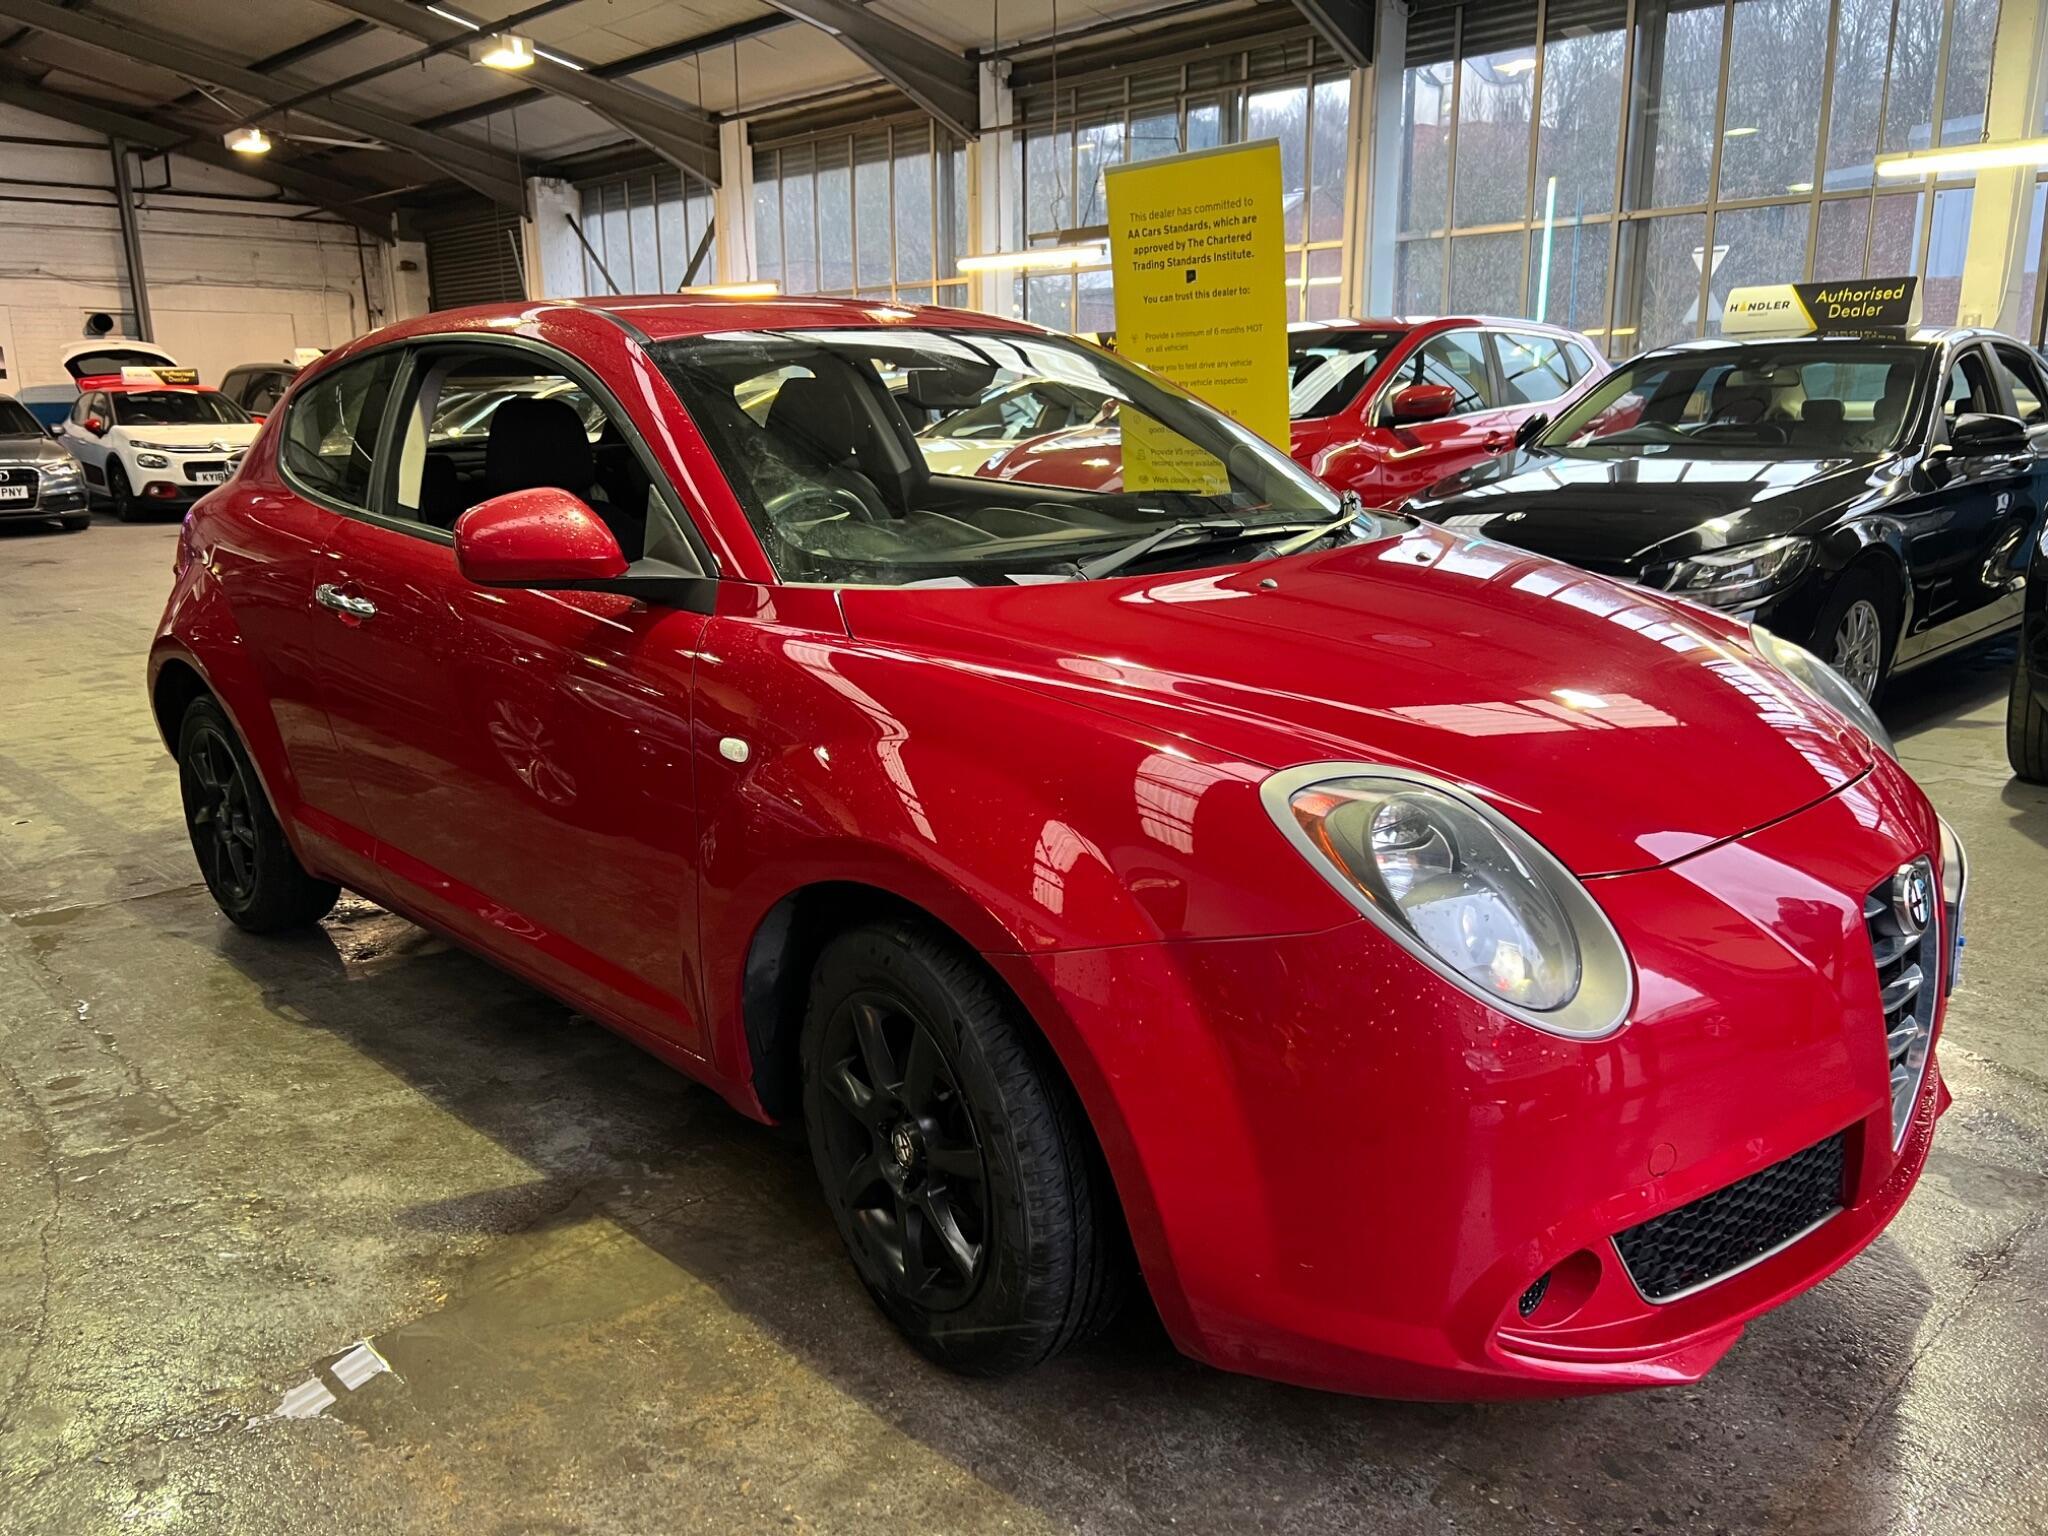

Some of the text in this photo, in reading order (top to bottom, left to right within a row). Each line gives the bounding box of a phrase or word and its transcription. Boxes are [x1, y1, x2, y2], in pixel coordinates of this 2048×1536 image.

[1130, 197, 1254, 222] This dealer has committed to
[1128, 215, 1257, 240] AA Cars Standards, which are
[1133, 231, 1252, 256] approved by The Chartered
[1132, 249, 1254, 271] Trading Standards Institute.
[1143, 287, 1250, 304] You can trust this dealer to:
[1815, 284, 1905, 304] Authorised
[1828, 302, 1884, 319] Dealer
[1144, 331, 1169, 340] Provide
[1206, 328, 1213, 336] of
[1220, 325, 1245, 335] months
[1246, 324, 1263, 333] MOT
[1145, 345, 1154, 353] on
[1179, 361, 1184, 370] to
[1185, 360, 1198, 370] test
[1198, 360, 1216, 369] drive
[1217, 360, 1230, 370] any
[1230, 358, 1253, 367] vehicle
[1189, 378, 1212, 387] vehicle
[1213, 377, 1248, 387] inspection
[2, 487, 22, 497] PNY
